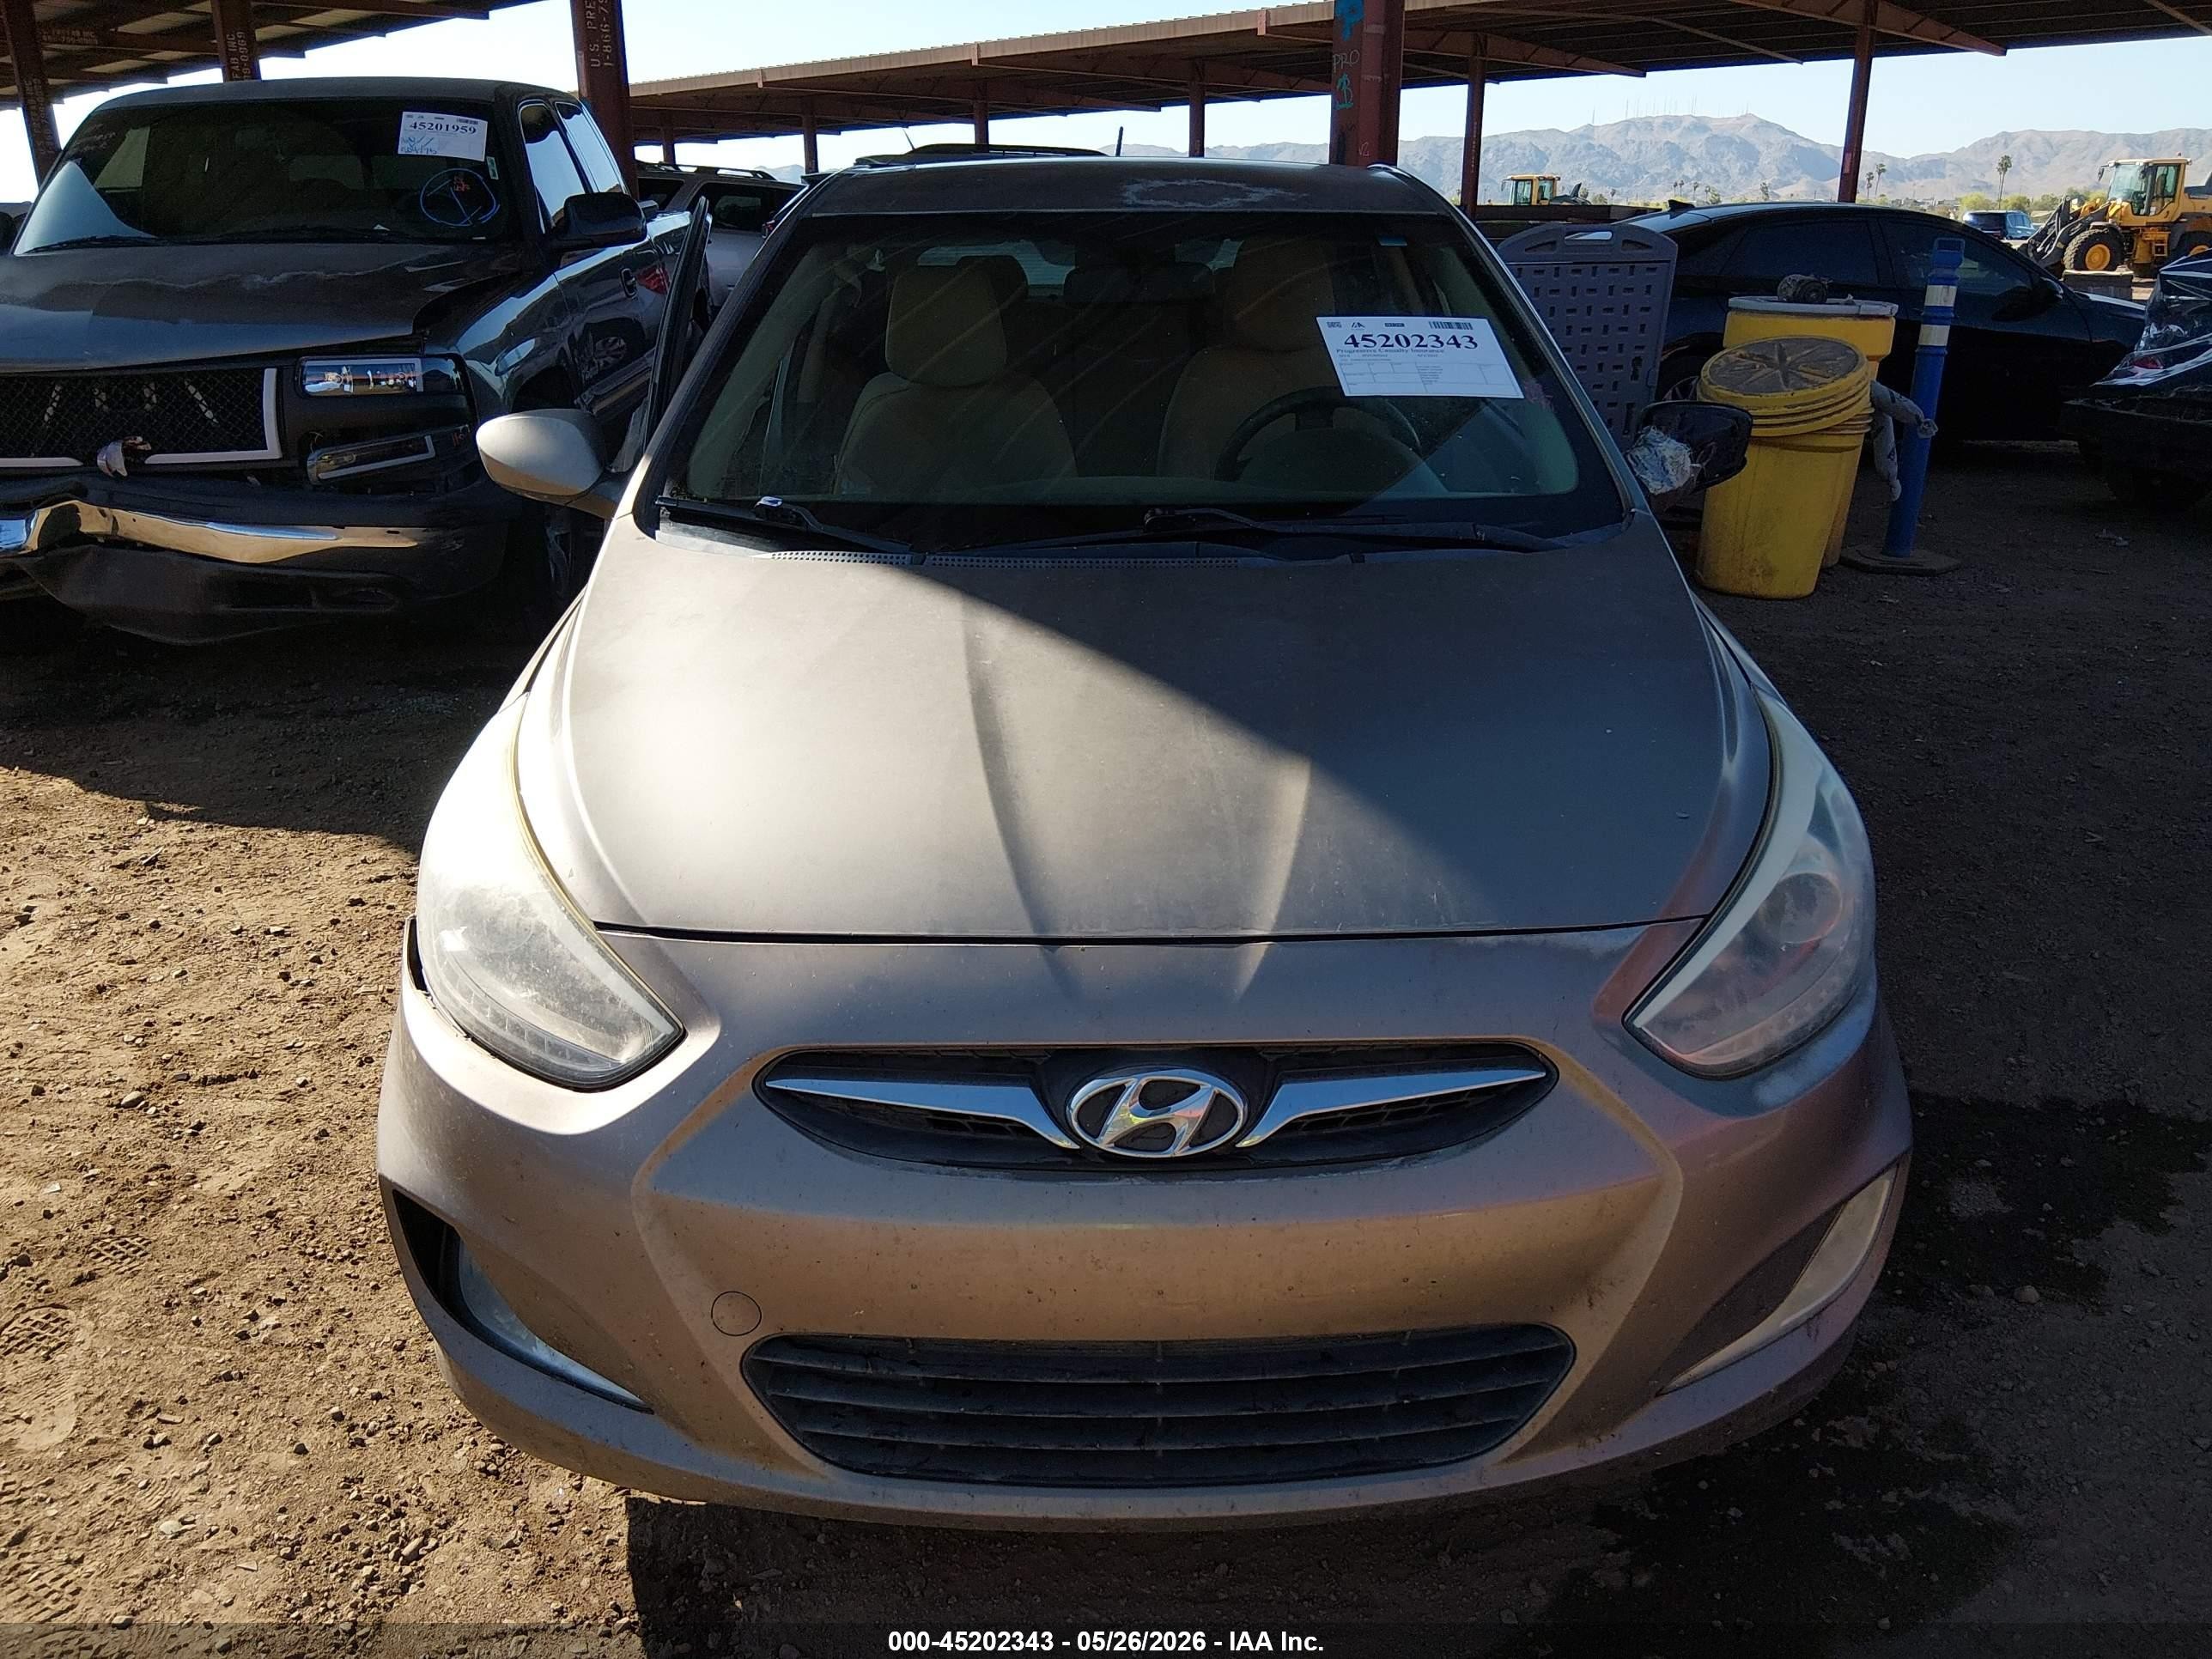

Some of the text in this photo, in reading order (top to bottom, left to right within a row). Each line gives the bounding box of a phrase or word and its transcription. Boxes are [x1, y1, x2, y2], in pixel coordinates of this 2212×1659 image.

[1332, 49, 1360, 73] PRO
[410, 121, 477, 135] 45201959
[1344, 333, 1478, 349] 45202343
